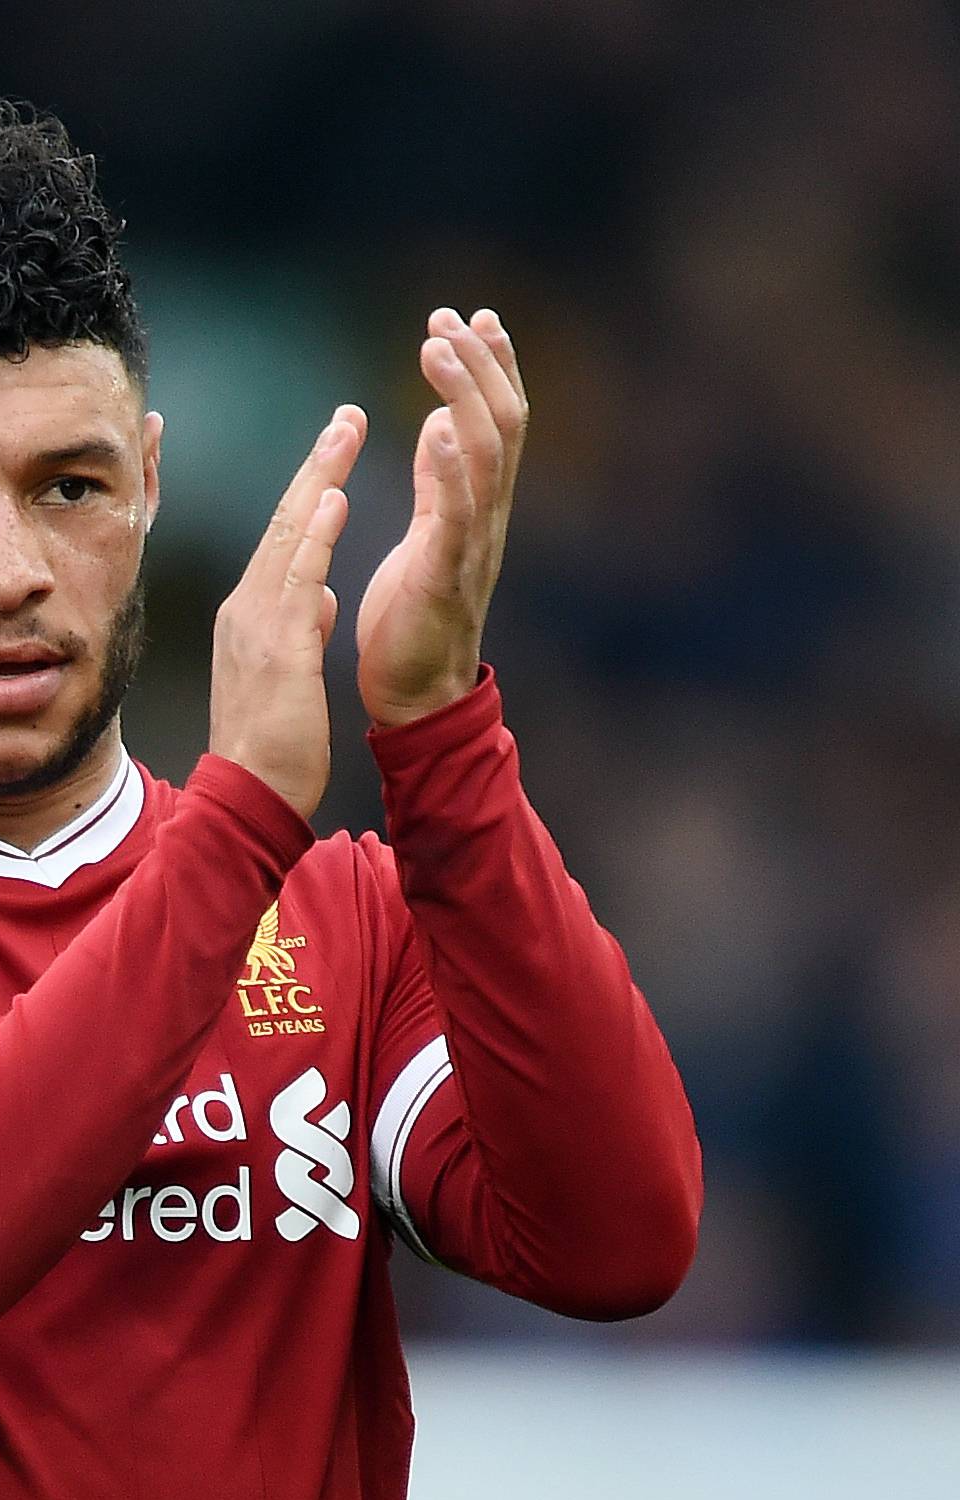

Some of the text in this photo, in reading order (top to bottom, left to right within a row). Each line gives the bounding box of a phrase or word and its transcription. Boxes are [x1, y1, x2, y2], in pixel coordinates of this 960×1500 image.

[277, 936, 307, 949] 2017
[237, 985, 323, 1017] L.F.C.
[248, 1019, 326, 1037] 125 YEARS
